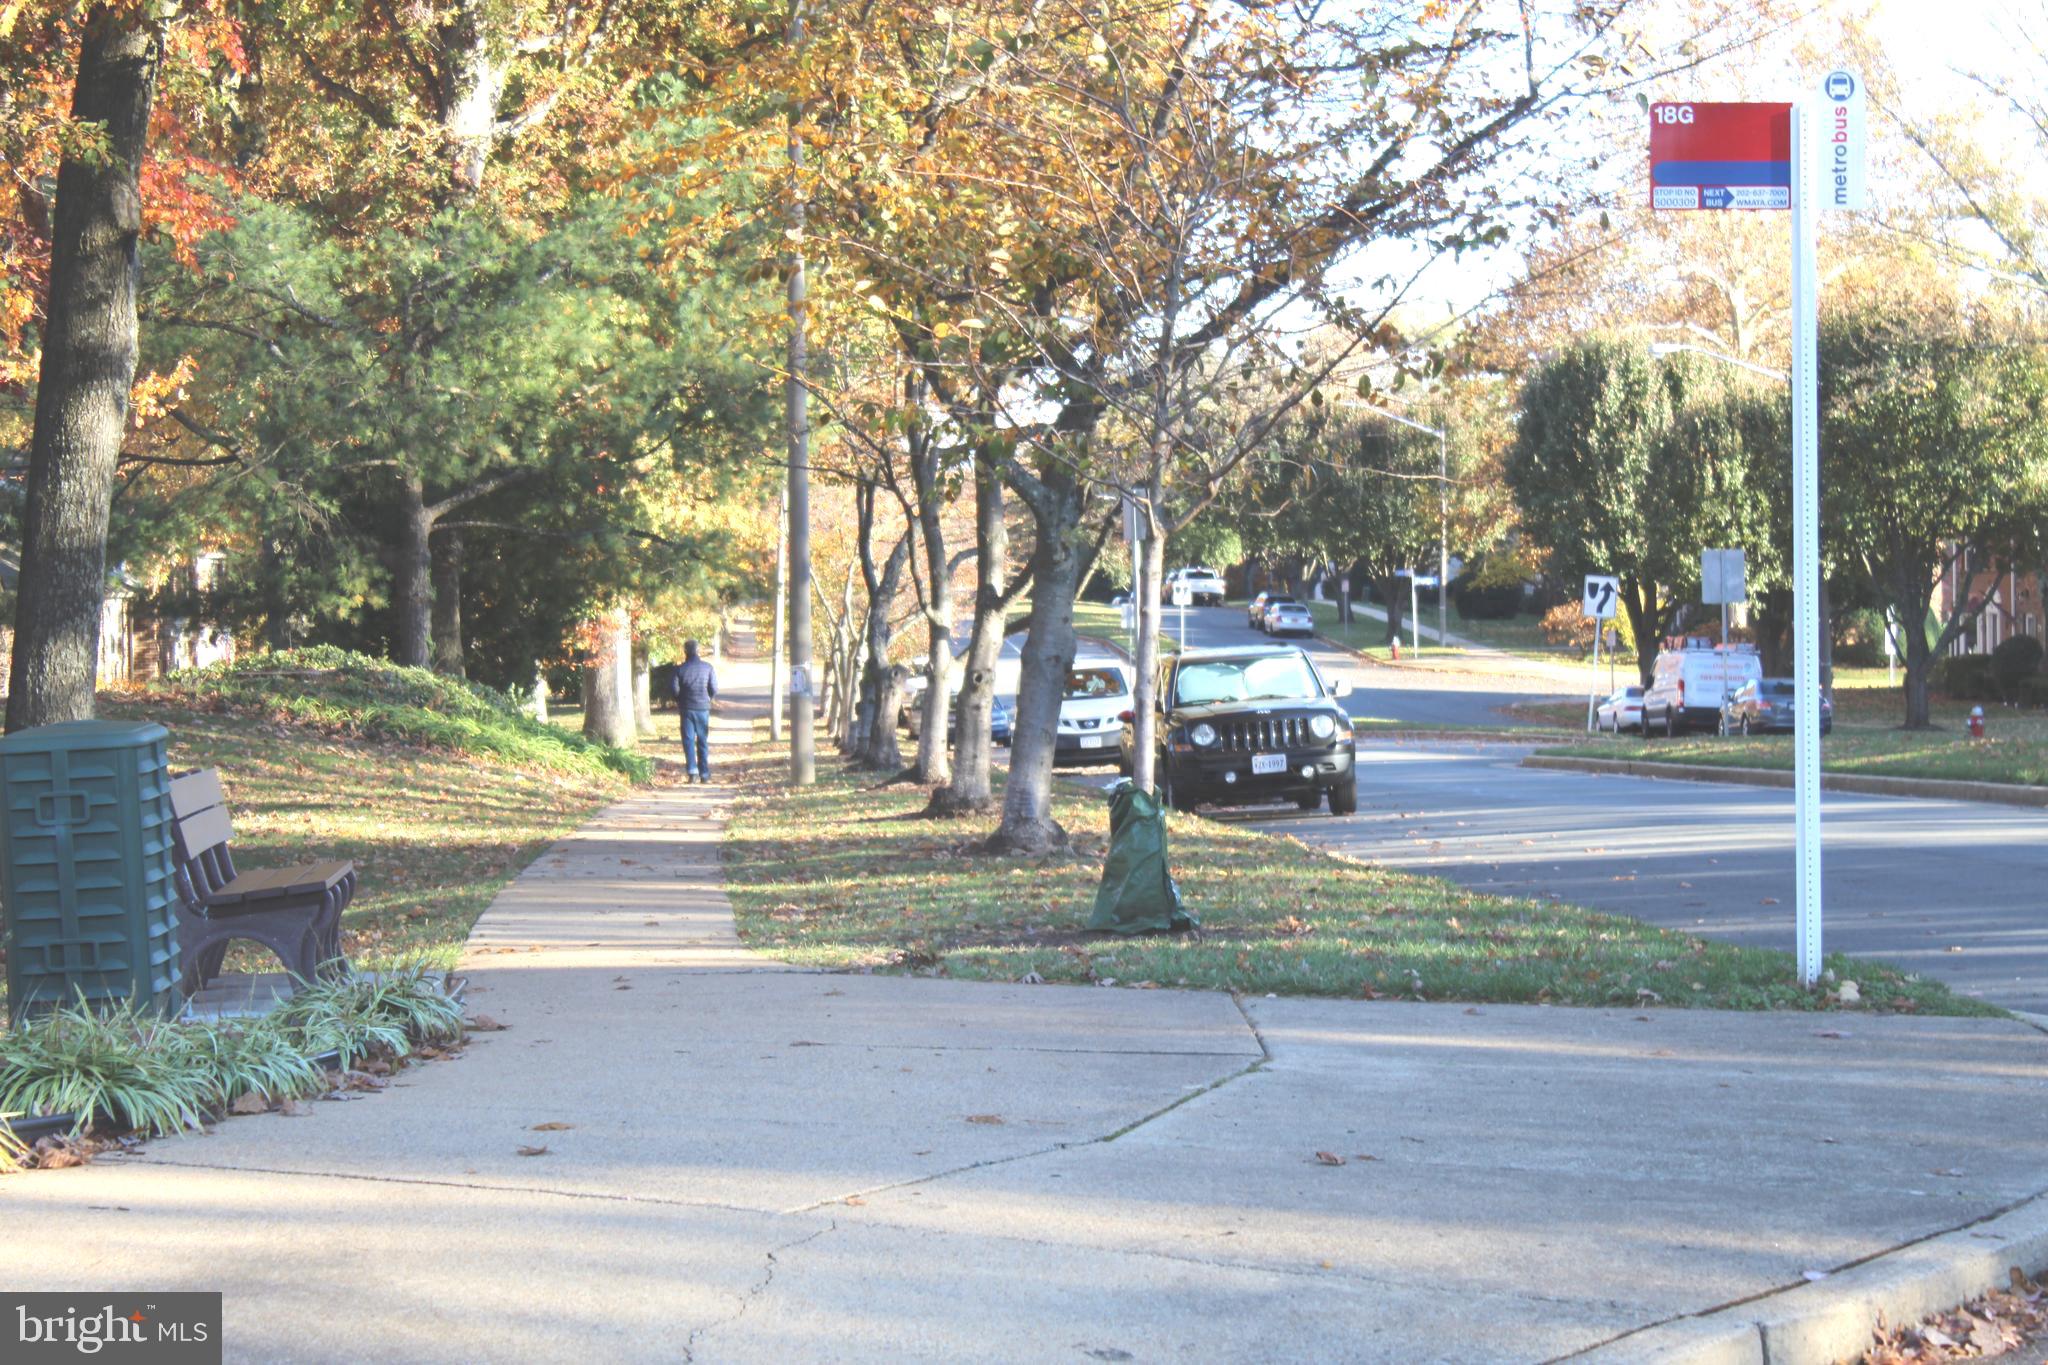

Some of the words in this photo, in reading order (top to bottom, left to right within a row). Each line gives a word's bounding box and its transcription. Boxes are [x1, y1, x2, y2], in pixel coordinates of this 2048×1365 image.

[1654, 106, 1694, 124] 18G
[1831, 106, 1848, 205] metrobus
[1703, 188, 1725, 198] NEXT
[1736, 189, 1788, 197] 202-637-7000
[1706, 198, 1723, 207] BUS
